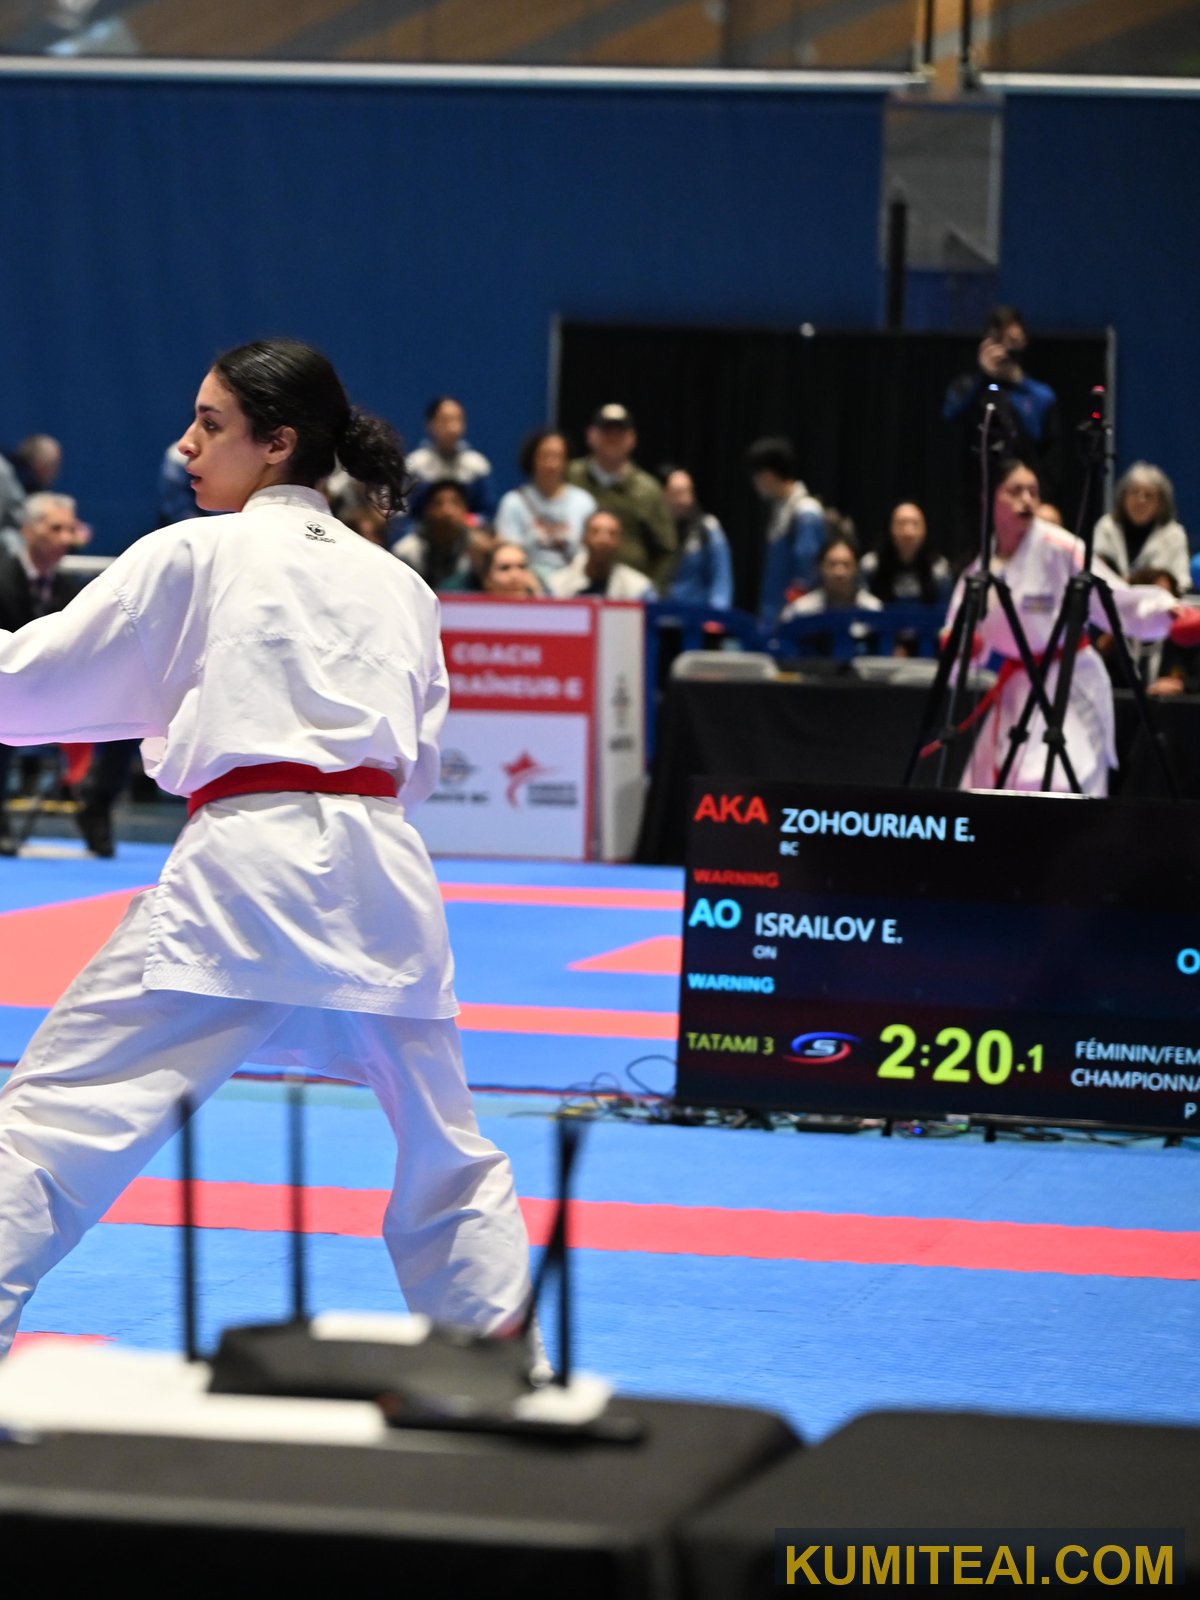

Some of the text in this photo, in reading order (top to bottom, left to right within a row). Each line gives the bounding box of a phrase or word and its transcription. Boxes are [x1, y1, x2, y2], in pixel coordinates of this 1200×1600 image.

[451, 642, 541, 667] COACH
[694, 794, 976, 842] AKA ZOHOURIAN E.
[779, 841, 799, 856] BC
[693, 869, 779, 888] WARNING
[688, 898, 903, 944] AO ISRAILOV E.
[753, 944, 777, 960] ON
[688, 973, 775, 994] WARNING
[687, 1032, 774, 1056] TATAMI 3
